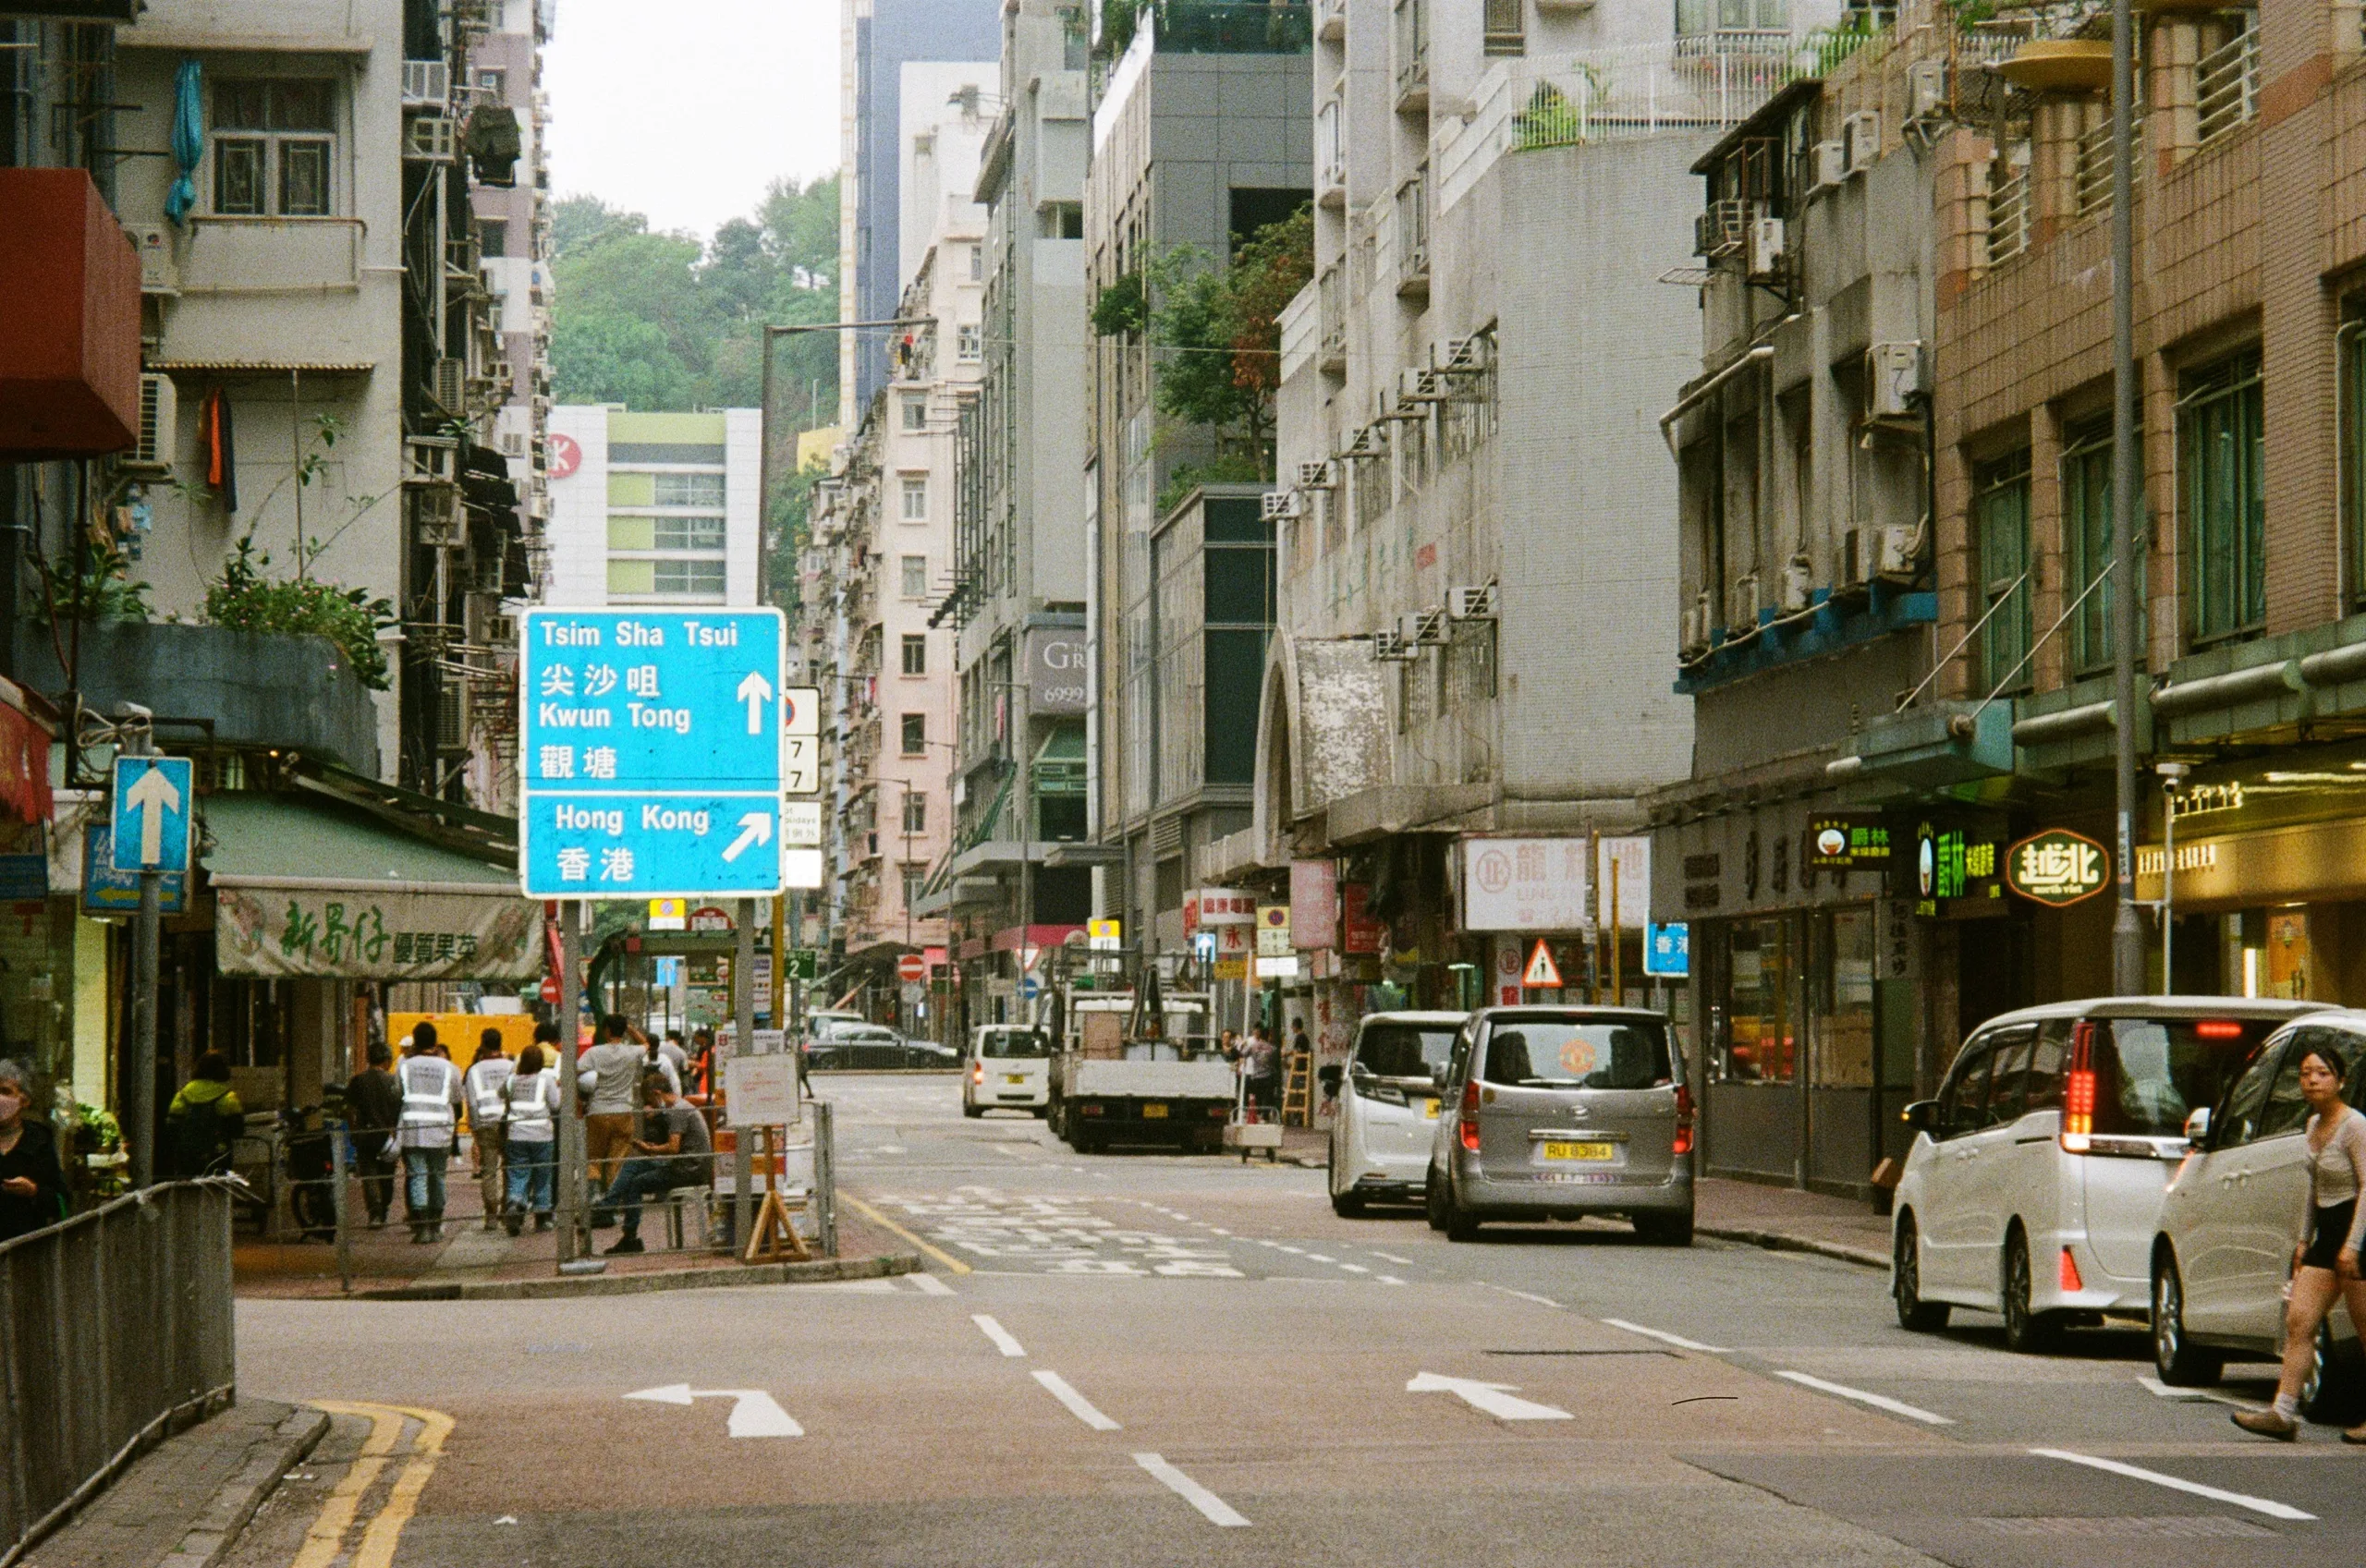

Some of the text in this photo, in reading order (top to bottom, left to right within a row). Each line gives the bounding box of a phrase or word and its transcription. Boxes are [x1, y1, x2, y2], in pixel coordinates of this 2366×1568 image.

[540, 621, 738, 647] Tsim Sha Tsui
[540, 663, 662, 698] 尖沙咀
[539, 702, 691, 735] Kwun Tong
[539, 745, 617, 779] 觀塘
[555, 804, 710, 836] Hong Kong
[556, 847, 635, 881] 香港
[280, 900, 391, 966] 新界仔
